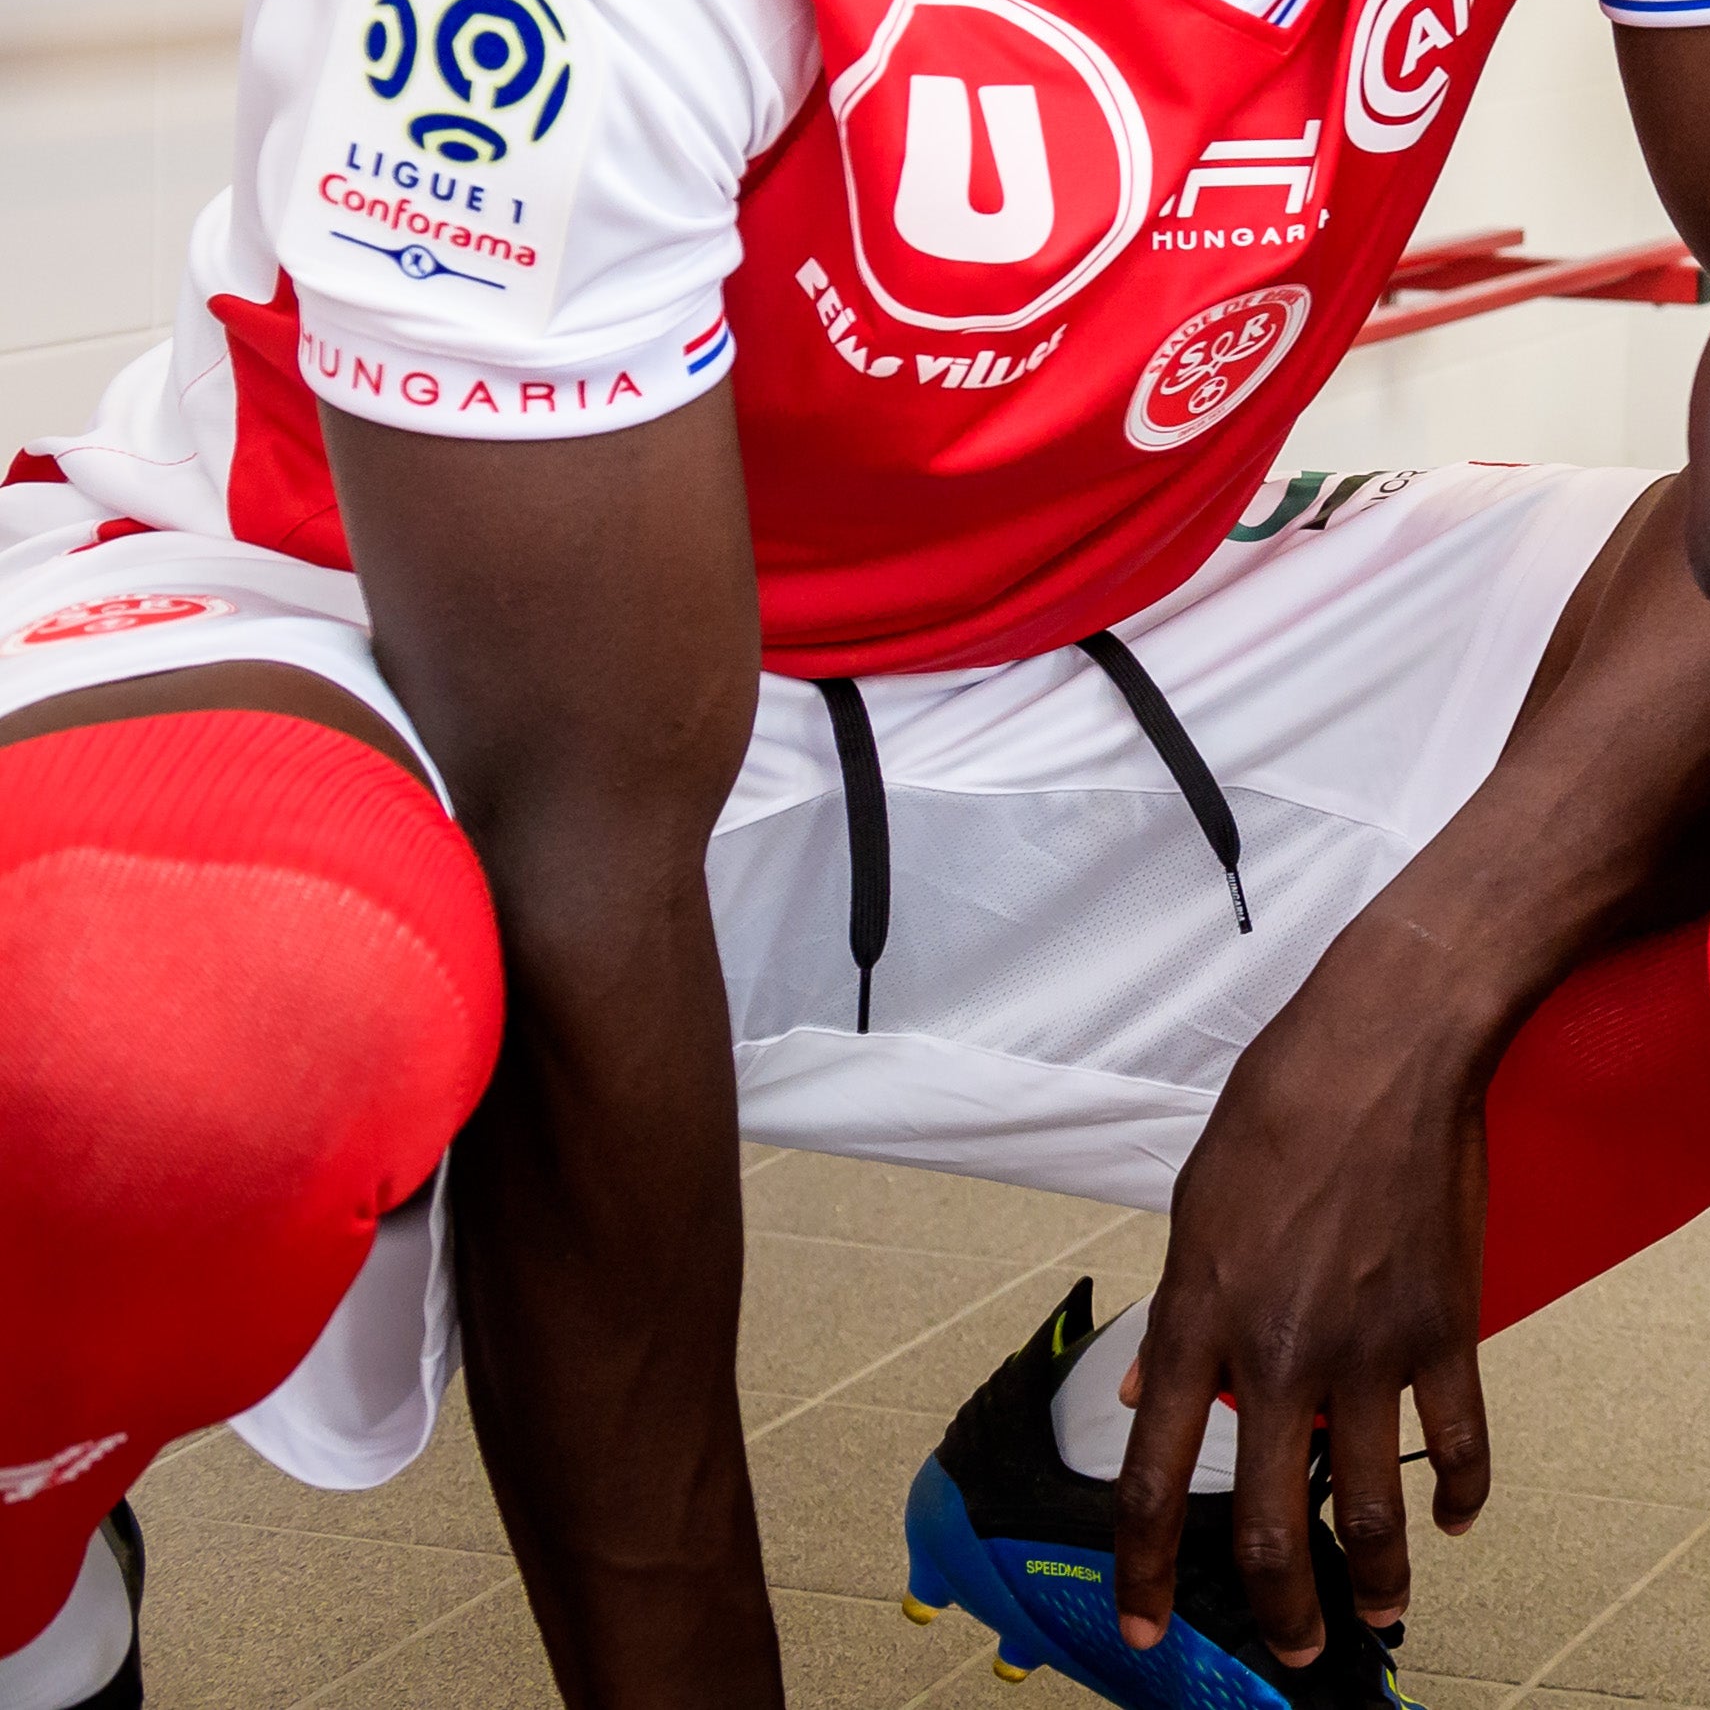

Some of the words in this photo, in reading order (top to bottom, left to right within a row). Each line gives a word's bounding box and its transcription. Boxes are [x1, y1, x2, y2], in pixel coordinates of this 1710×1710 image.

[345, 142, 488, 213] LIGUE
[511, 198, 525, 224] 1
[893, 74, 1055, 264] U
[317, 173, 537, 267] Conforama
[299, 323, 643, 414] HUNGARIA
[1026, 1559, 1102, 1584] SPEEDMESH
